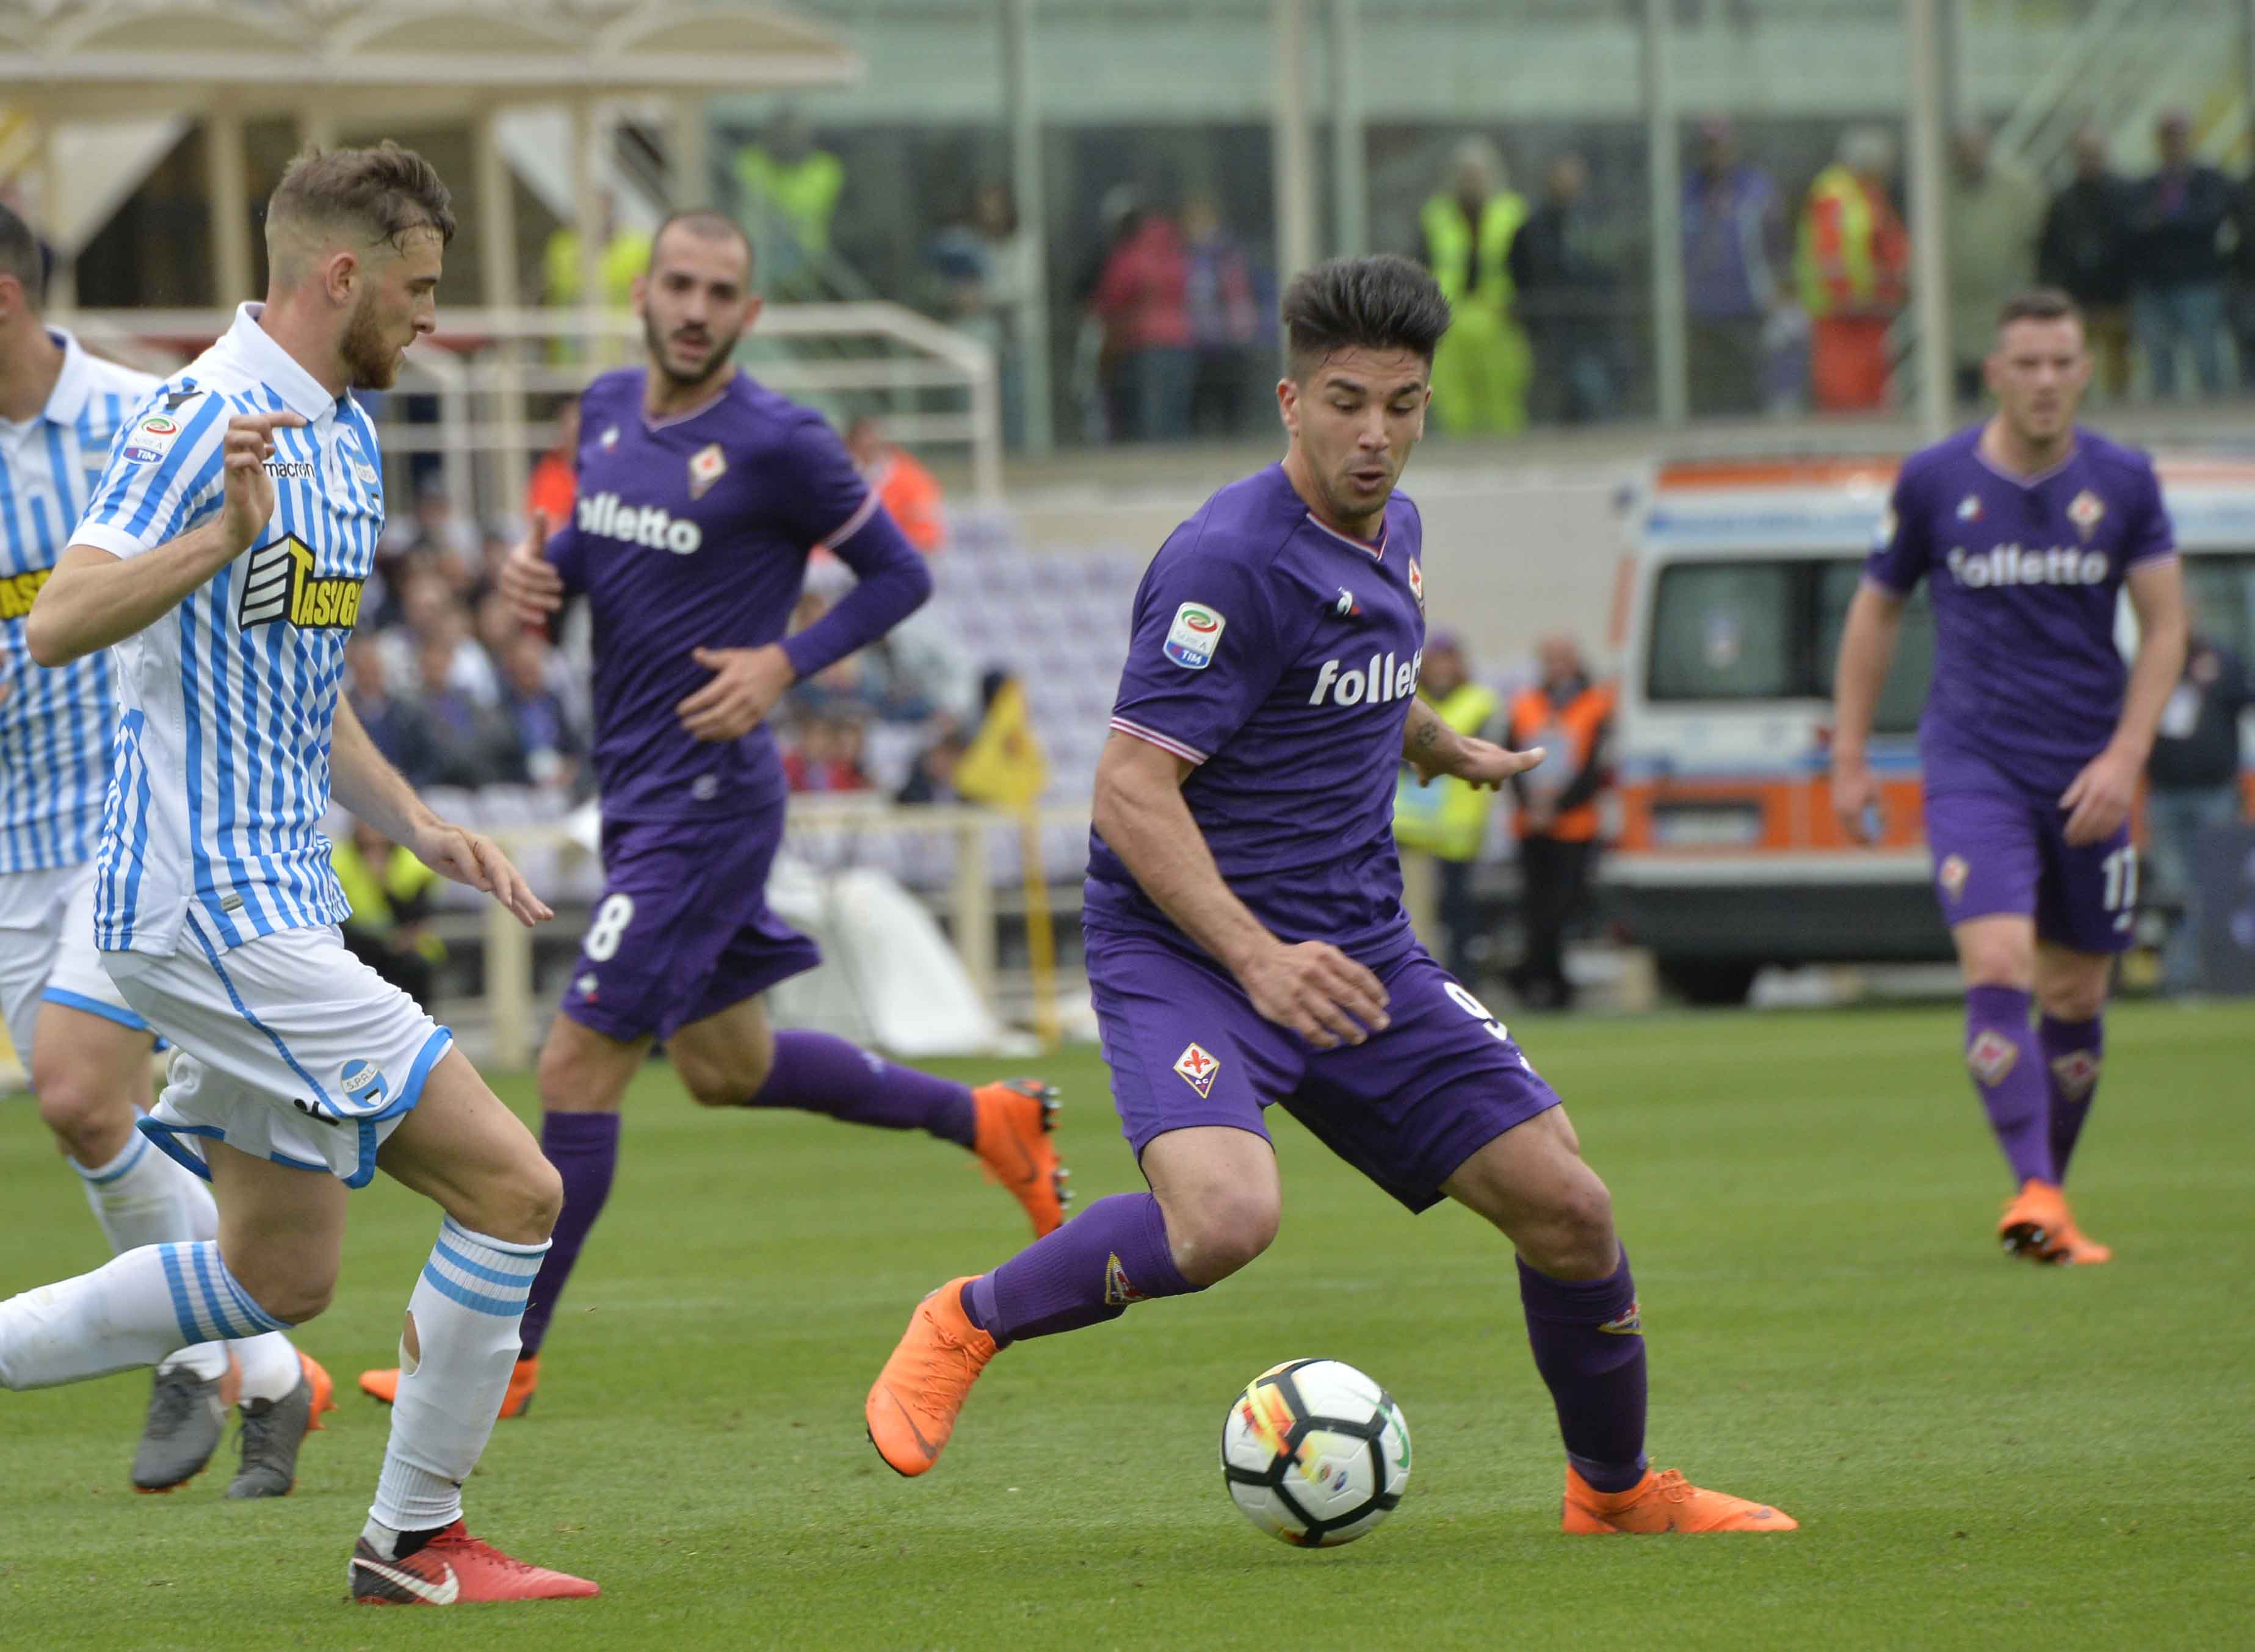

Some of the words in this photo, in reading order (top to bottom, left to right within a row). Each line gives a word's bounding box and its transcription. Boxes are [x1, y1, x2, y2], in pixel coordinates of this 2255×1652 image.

[1181, 649, 1203, 664] TIM
[586, 893, 635, 962] 8
[1443, 981, 1508, 1041] 9
